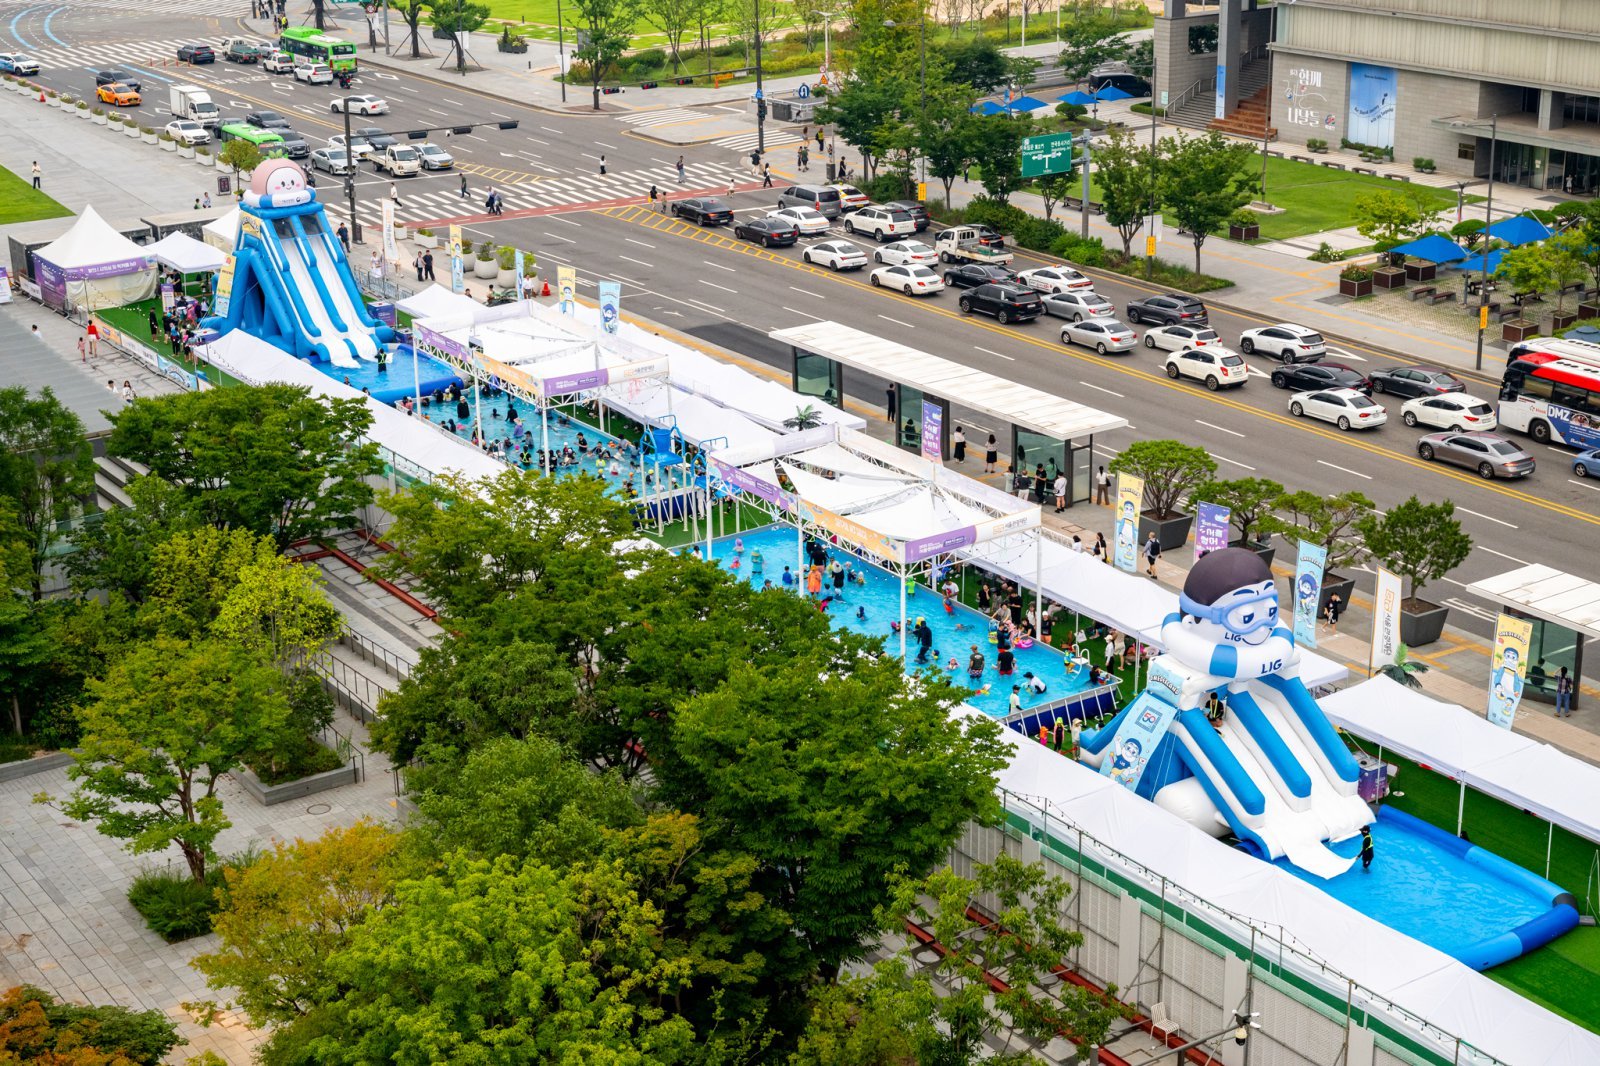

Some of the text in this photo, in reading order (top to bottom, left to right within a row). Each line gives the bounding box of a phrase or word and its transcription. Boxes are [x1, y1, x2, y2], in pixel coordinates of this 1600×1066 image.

[1299, 68, 1321, 87] 함께
[1288, 107, 1320, 128] 나날들
[1548, 405, 1571, 421] DMZ
[1224, 632, 1242, 642] LIG
[1260, 659, 1283, 675] LIG
[1141, 712, 1157, 724] 50
